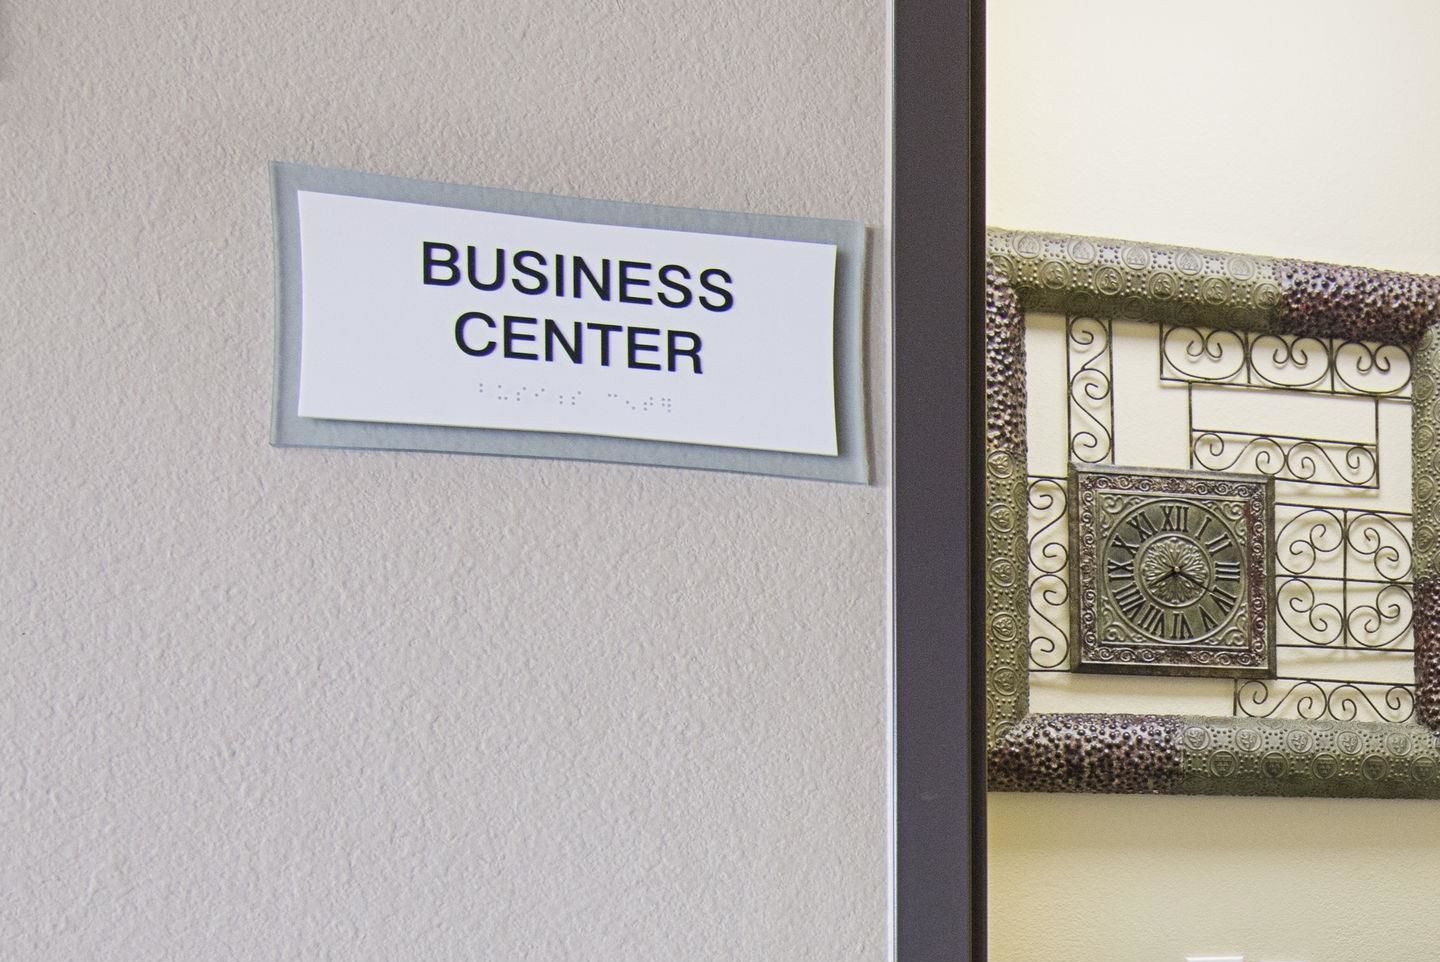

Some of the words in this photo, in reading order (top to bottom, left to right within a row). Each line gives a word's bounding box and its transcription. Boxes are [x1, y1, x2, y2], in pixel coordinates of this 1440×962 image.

[422, 241, 734, 313] BUSINESS
[454, 311, 703, 375] CENTER
[1160, 505, 1190, 533] XII
